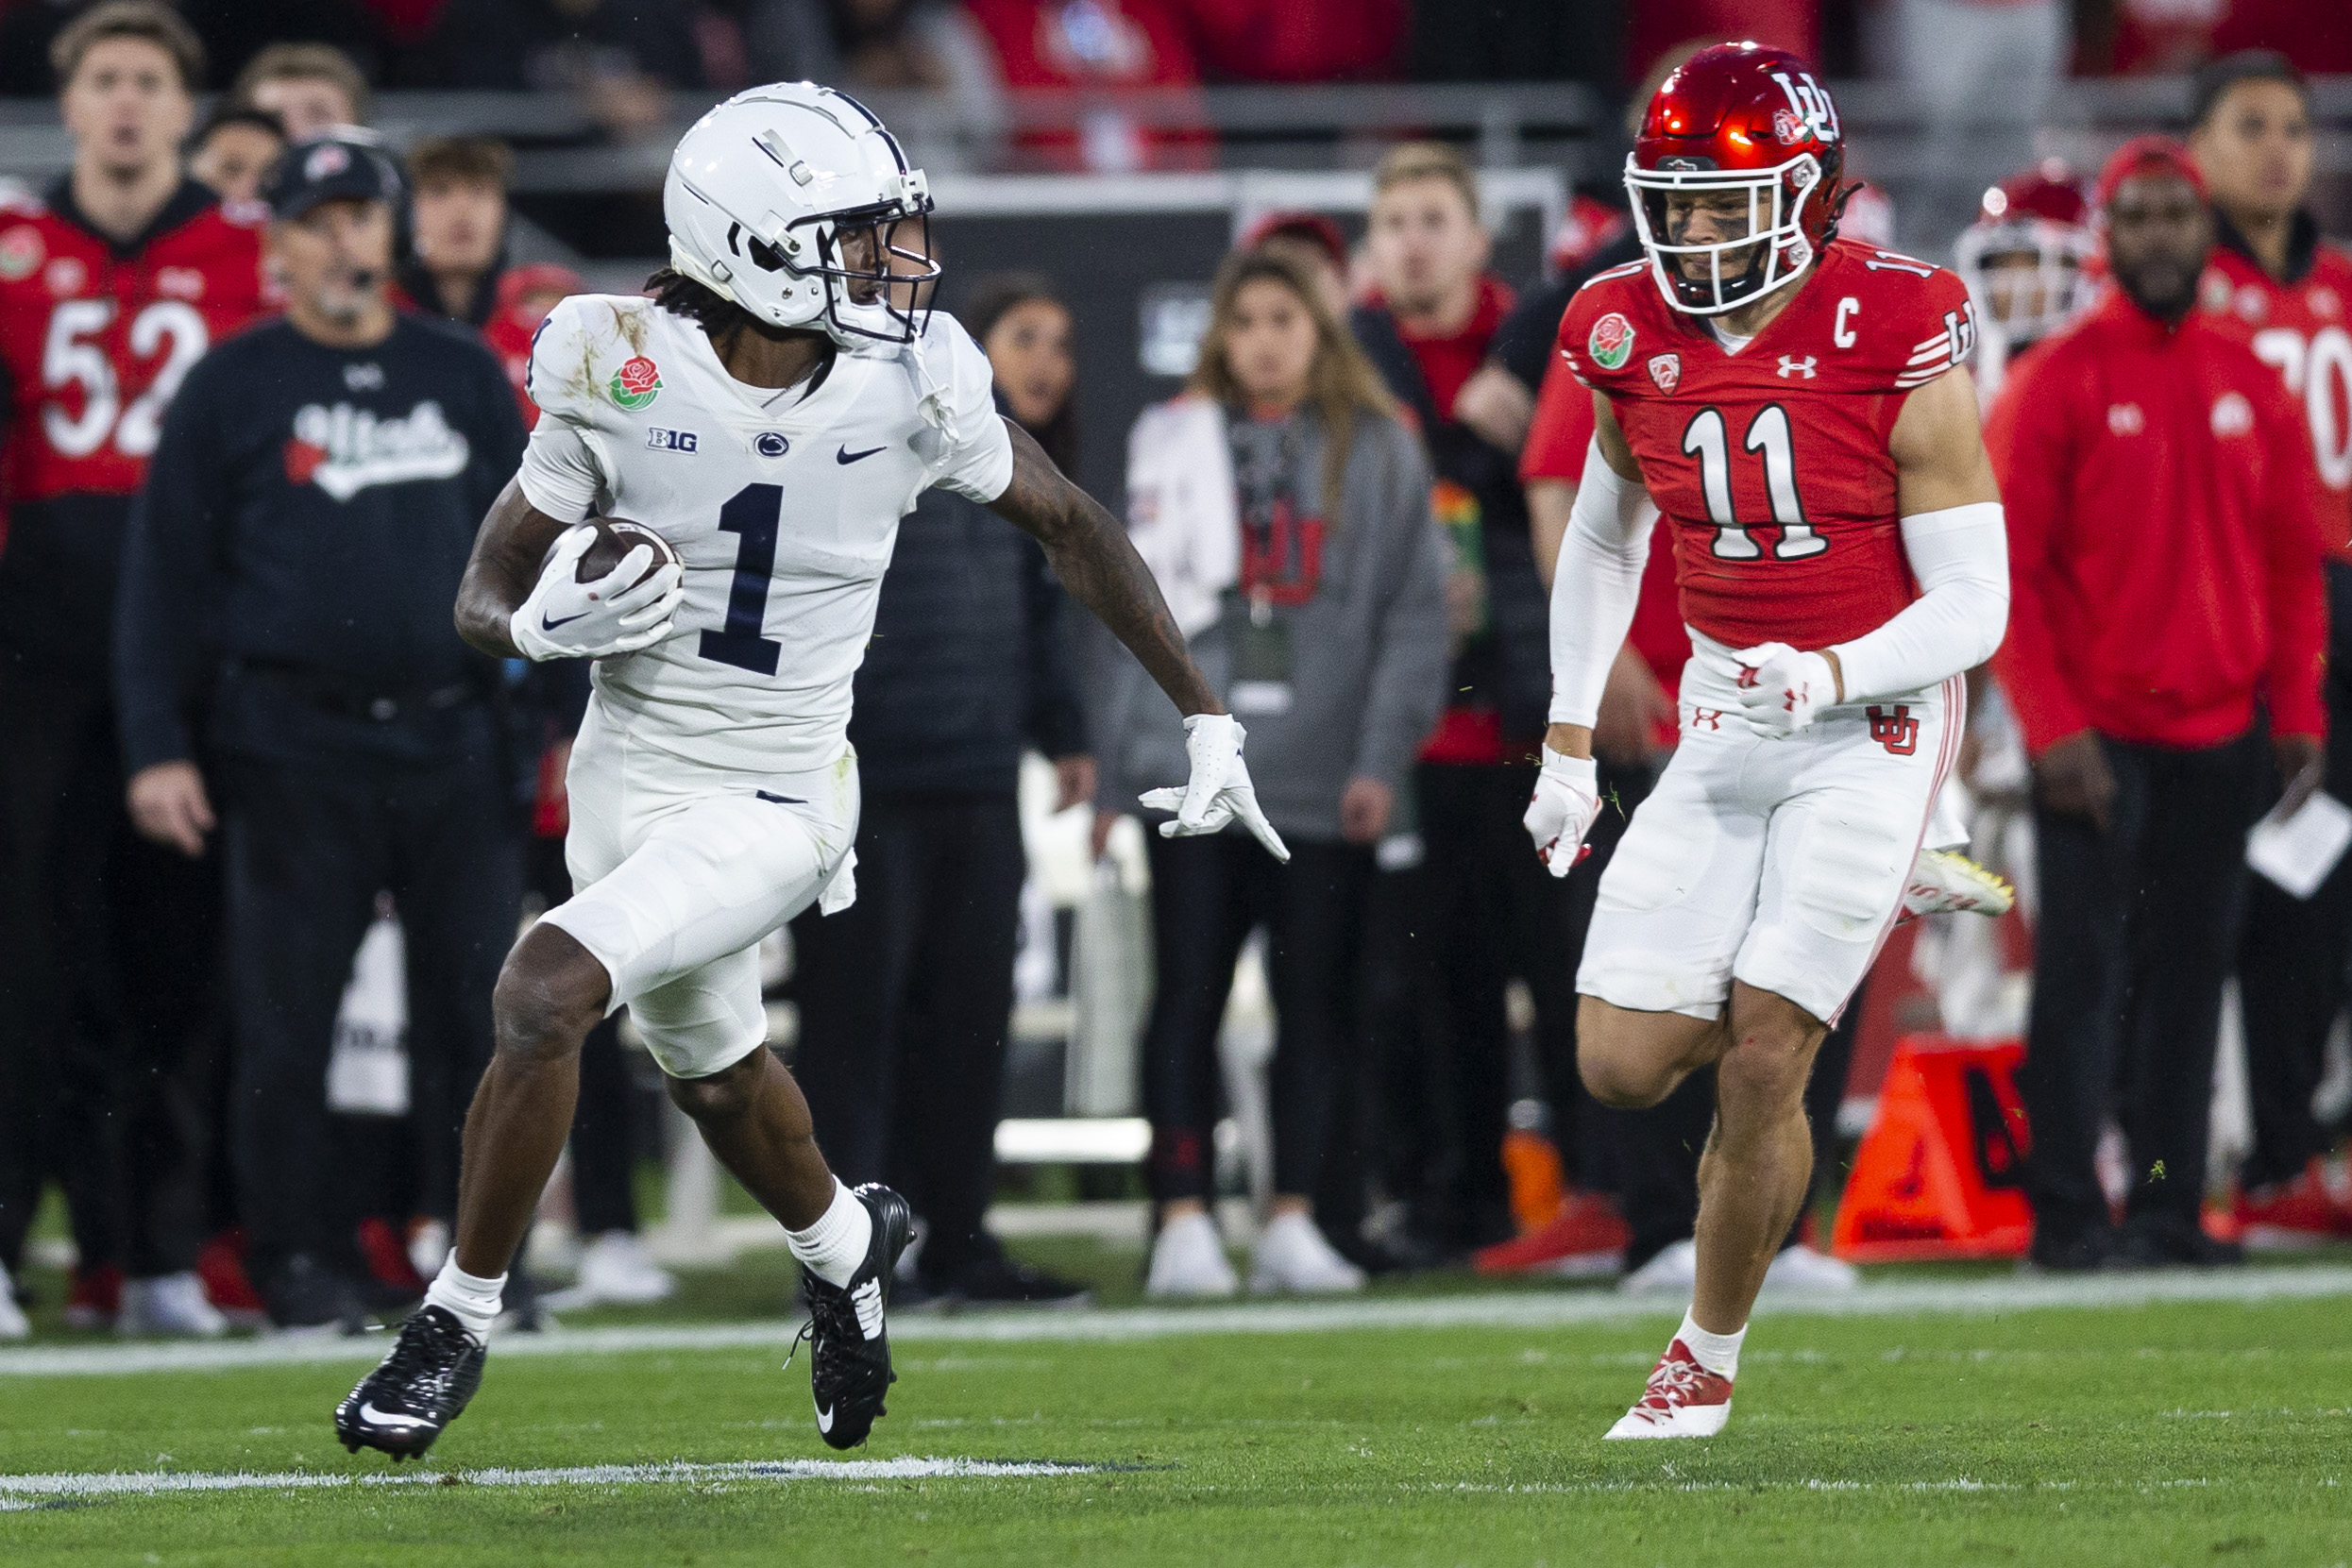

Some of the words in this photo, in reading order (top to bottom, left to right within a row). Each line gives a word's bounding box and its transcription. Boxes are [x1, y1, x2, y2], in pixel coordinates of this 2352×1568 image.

[41, 296, 211, 461] 52
[1834, 295, 1860, 349] C
[1681, 401, 1830, 562] 11
[697, 481, 785, 678] 1
[851, 1275, 884, 1341] NIKE
